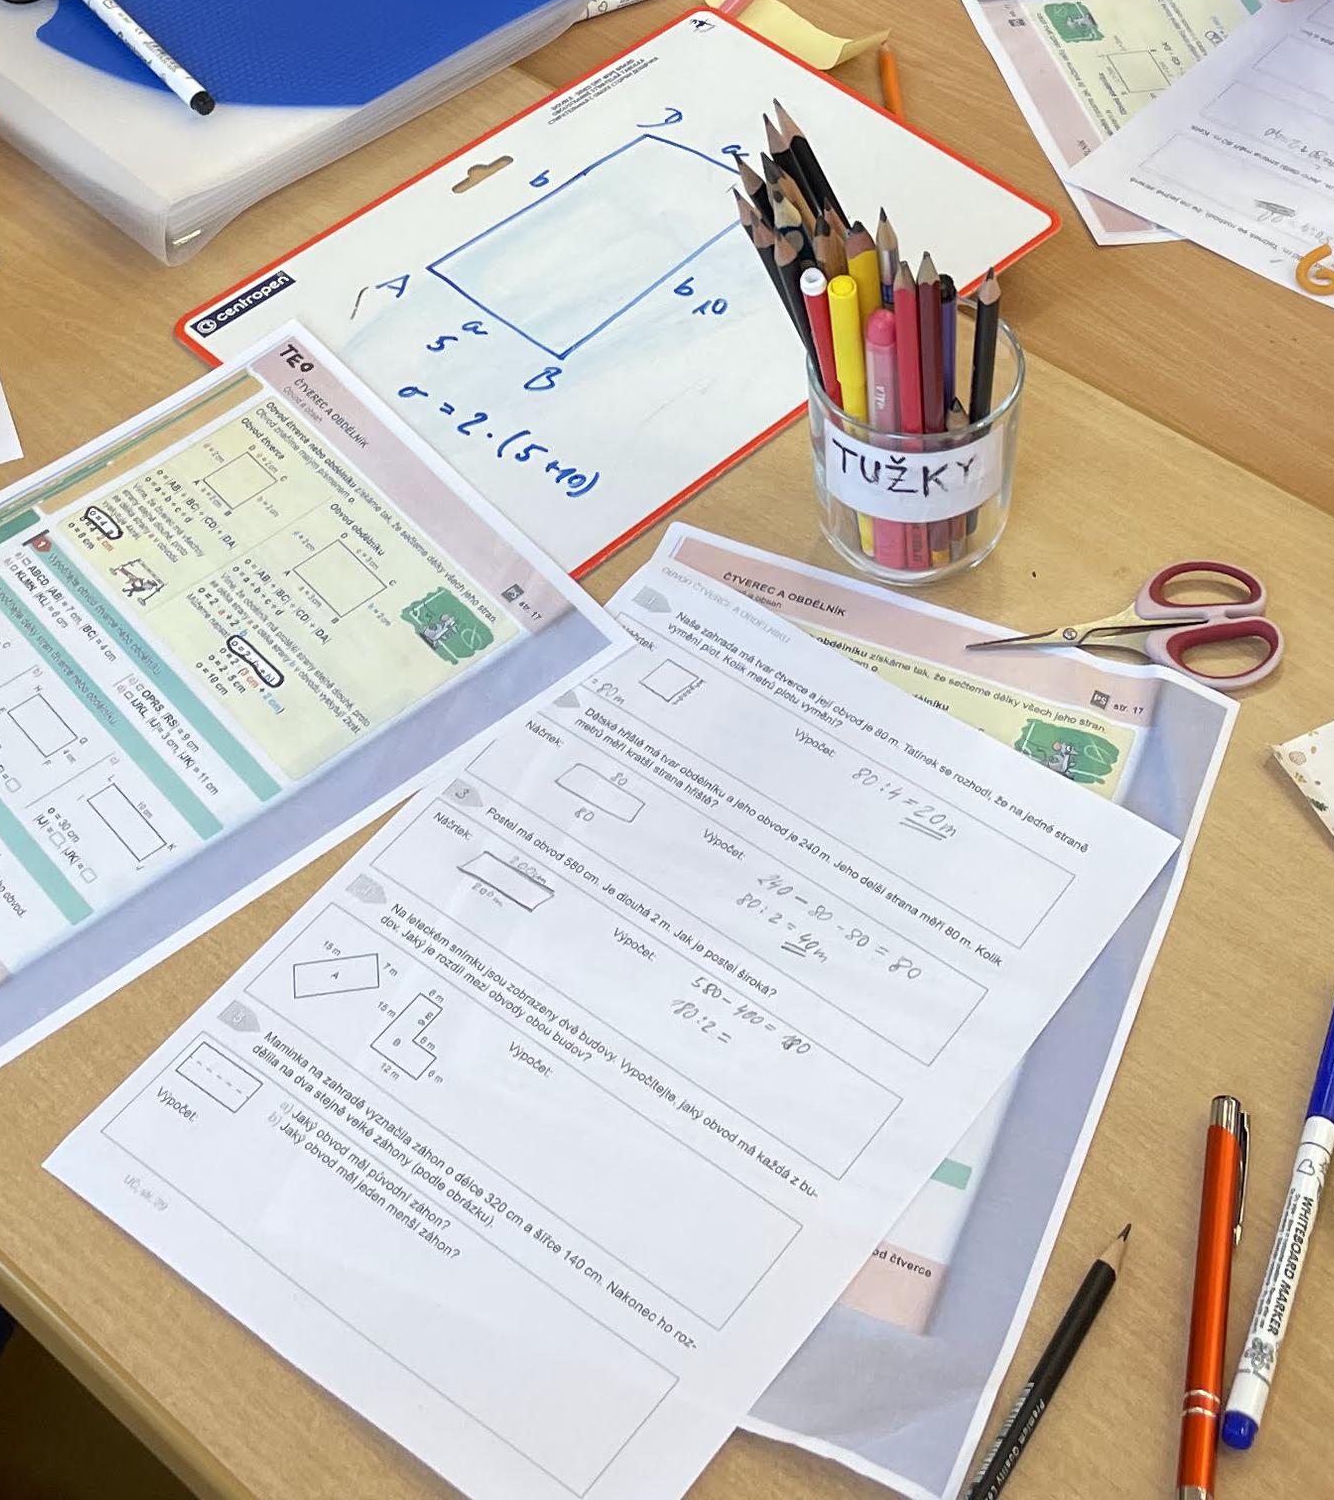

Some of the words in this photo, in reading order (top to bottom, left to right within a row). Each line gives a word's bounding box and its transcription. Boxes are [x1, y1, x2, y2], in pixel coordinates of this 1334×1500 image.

[215, 273, 291, 326] centropen
[376, 272, 411, 299] A
[278, 342, 315, 373] TEO
[523, 365, 562, 391] B
[292, 375, 329, 412] ČTVEREC
[321, 404, 336, 417] A
[329, 410, 370, 450] OBDÉLNÍK
[239, 415, 266, 440] Obvod
[258, 434, 286, 461] čtverce
[262, 398, 294, 425] Obvod
[280, 416, 317, 446] čtverce
[305, 438, 332, 461] nebo
[322, 453, 362, 491] obdélníku
[831, 437, 977, 498] TUŽKY
[328, 501, 356, 526] Obvod
[349, 522, 386, 557] obdélníku
[717, 569, 777, 596] ČTVEREC
[774, 588, 788, 602] A
[786, 589, 848, 620] OBDÉLNÍK
[673, 610, 702, 632] Naše
[696, 626, 740, 655] zahrada
[736, 648, 760, 665] má
[750, 657, 778, 675] tvar
[772, 669, 809, 696] čtverce
[806, 690, 821, 701] a
[812, 693, 836, 710] její
[830, 704, 867, 728] obvod
[1051, 705, 1081, 725] jeho
[523, 718, 565, 749] Náčrtek:
[858, 719, 878, 733] je
[872, 725, 890, 742] 80
[793, 724, 837, 759] Výpočet:
[885, 735, 906, 750] m.
[899, 741, 940, 771] Tatínek
[937, 763, 953, 777] se
[950, 771, 994, 802] rozhodl,
[989, 793, 1012, 808] že
[1006, 803, 1024, 818] na
[1019, 810, 1058, 834] jedné
[1052, 829, 1090, 854] straně
[483, 805, 519, 832] Postel
[511, 826, 535, 843] má
[531, 837, 567, 862] obvod
[562, 855, 586, 875] 580
[581, 867, 603, 888] cm.
[600, 882, 617, 896] Je
[612, 891, 652, 920] dlouhá
[647, 911, 662, 925] 2
[656, 915, 675, 934] m.
[671, 927, 695, 947] Jak
[688, 938, 705, 953] je
[701, 947, 741, 975] postel
[732, 967, 778, 999] široká?
[389, 901, 408, 919] Na
[404, 911, 450, 949] leteckém
[447, 942, 487, 973] snímku
[479, 964, 508, 988] jsou
[504, 981, 562, 1024] zobrazeny
[557, 1016, 580, 1037] dvě
[576, 1027, 619, 1065] budovy.
[618, 1055, 681, 1108] Vypočítejte,
[674, 1097, 705, 1121] jaký
[701, 1115, 740, 1145] obvod
[733, 1138, 757, 1157] má
[753, 1148, 792, 1180] každá
[788, 1173, 800, 1187] z
[797, 1178, 819, 1199] bu-
[262, 1029, 310, 1069] Maminka
[306, 1063, 324, 1081] na
[320, 1074, 367, 1111] zahradě
[363, 1104, 413, 1147] vyznačila
[409, 1139, 446, 1172] záhon
[443, 1164, 455, 1178] o
[452, 1171, 485, 1198] délce
[481, 1191, 509, 1214] 320
[504, 1208, 524, 1229] cm
[522, 1221, 534, 1236] a
[531, 1226, 565, 1255] šířce
[562, 1248, 586, 1271] 140
[582, 1265, 603, 1287] cm.
[604, 1278, 658, 1323] Nakonec
[654, 1314, 676, 1334] ho
[671, 1329, 698, 1349] roz-
[1282, 1196, 1314, 1280] WHITEBOARD
[887, 1249, 935, 1278] čtverce
[1267, 1279, 1292, 1336] MARKER
